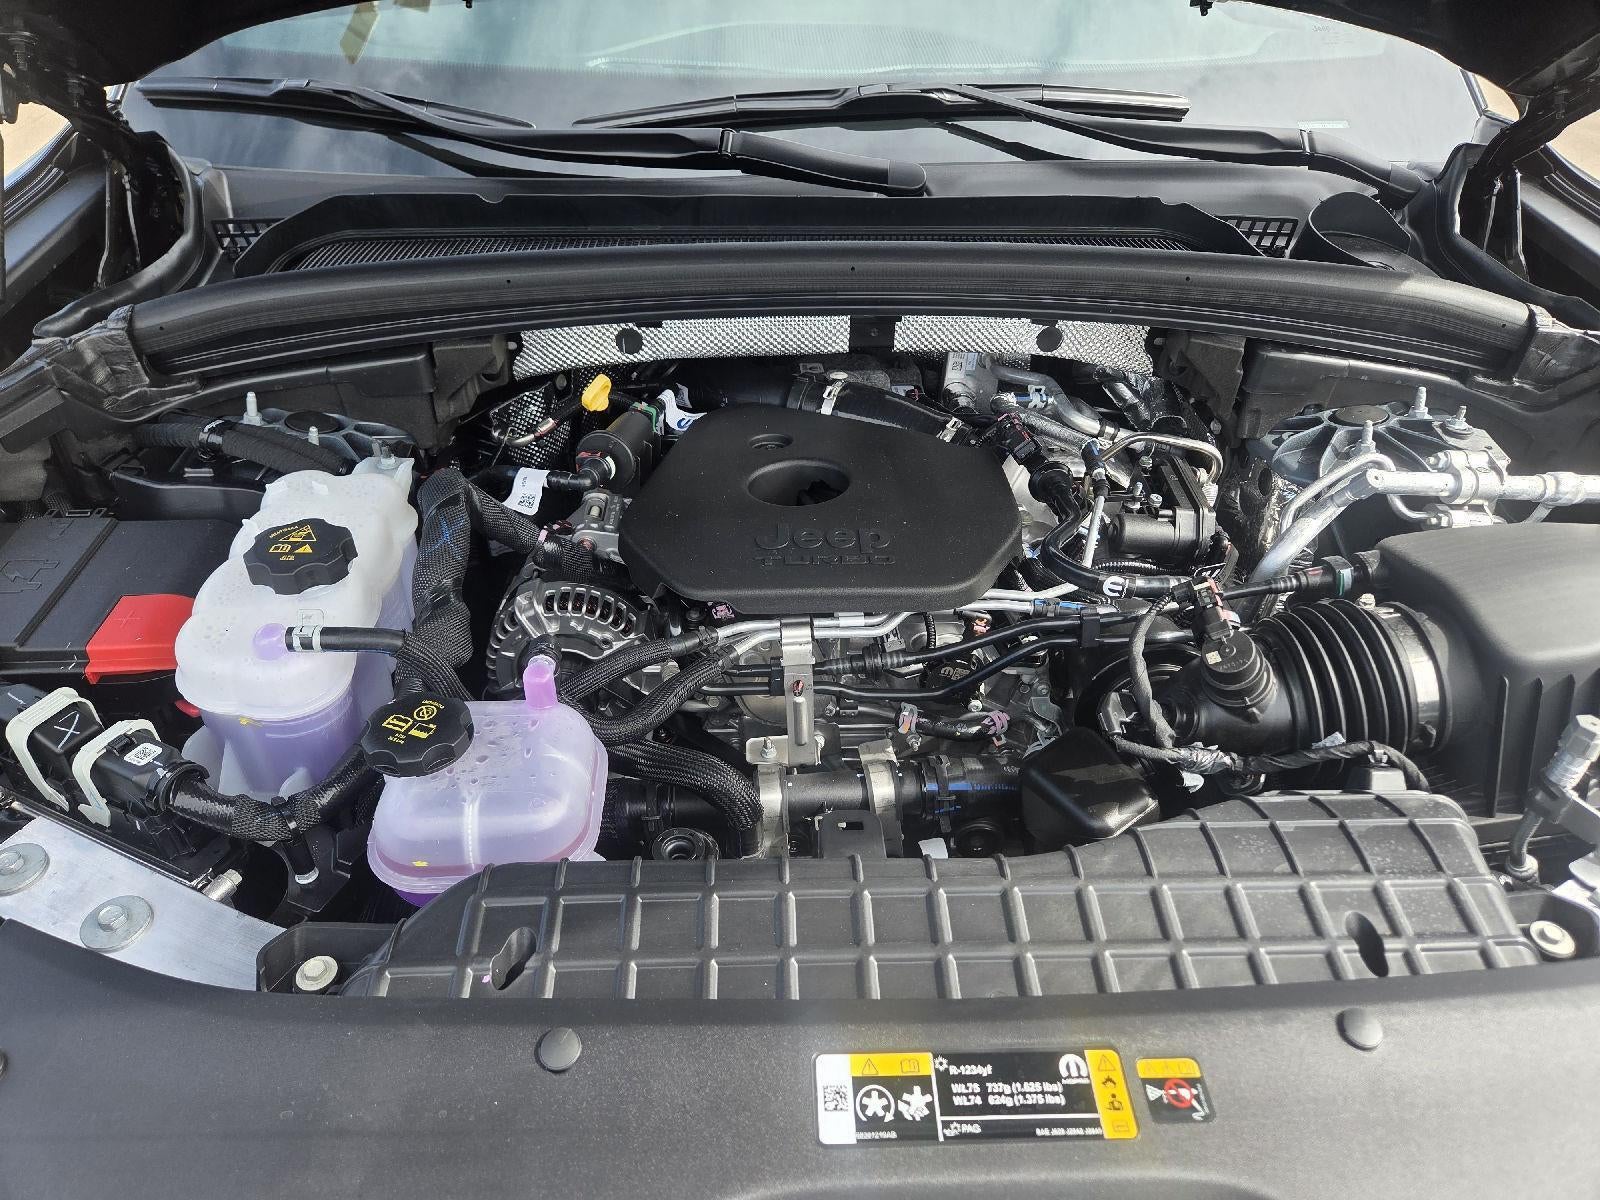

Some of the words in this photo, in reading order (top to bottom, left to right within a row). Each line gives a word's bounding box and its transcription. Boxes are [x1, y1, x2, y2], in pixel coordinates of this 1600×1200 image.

[754, 522, 892, 553] Jeep
[752, 555, 896, 565] TURBO
[953, 1095, 982, 1105] WL74
